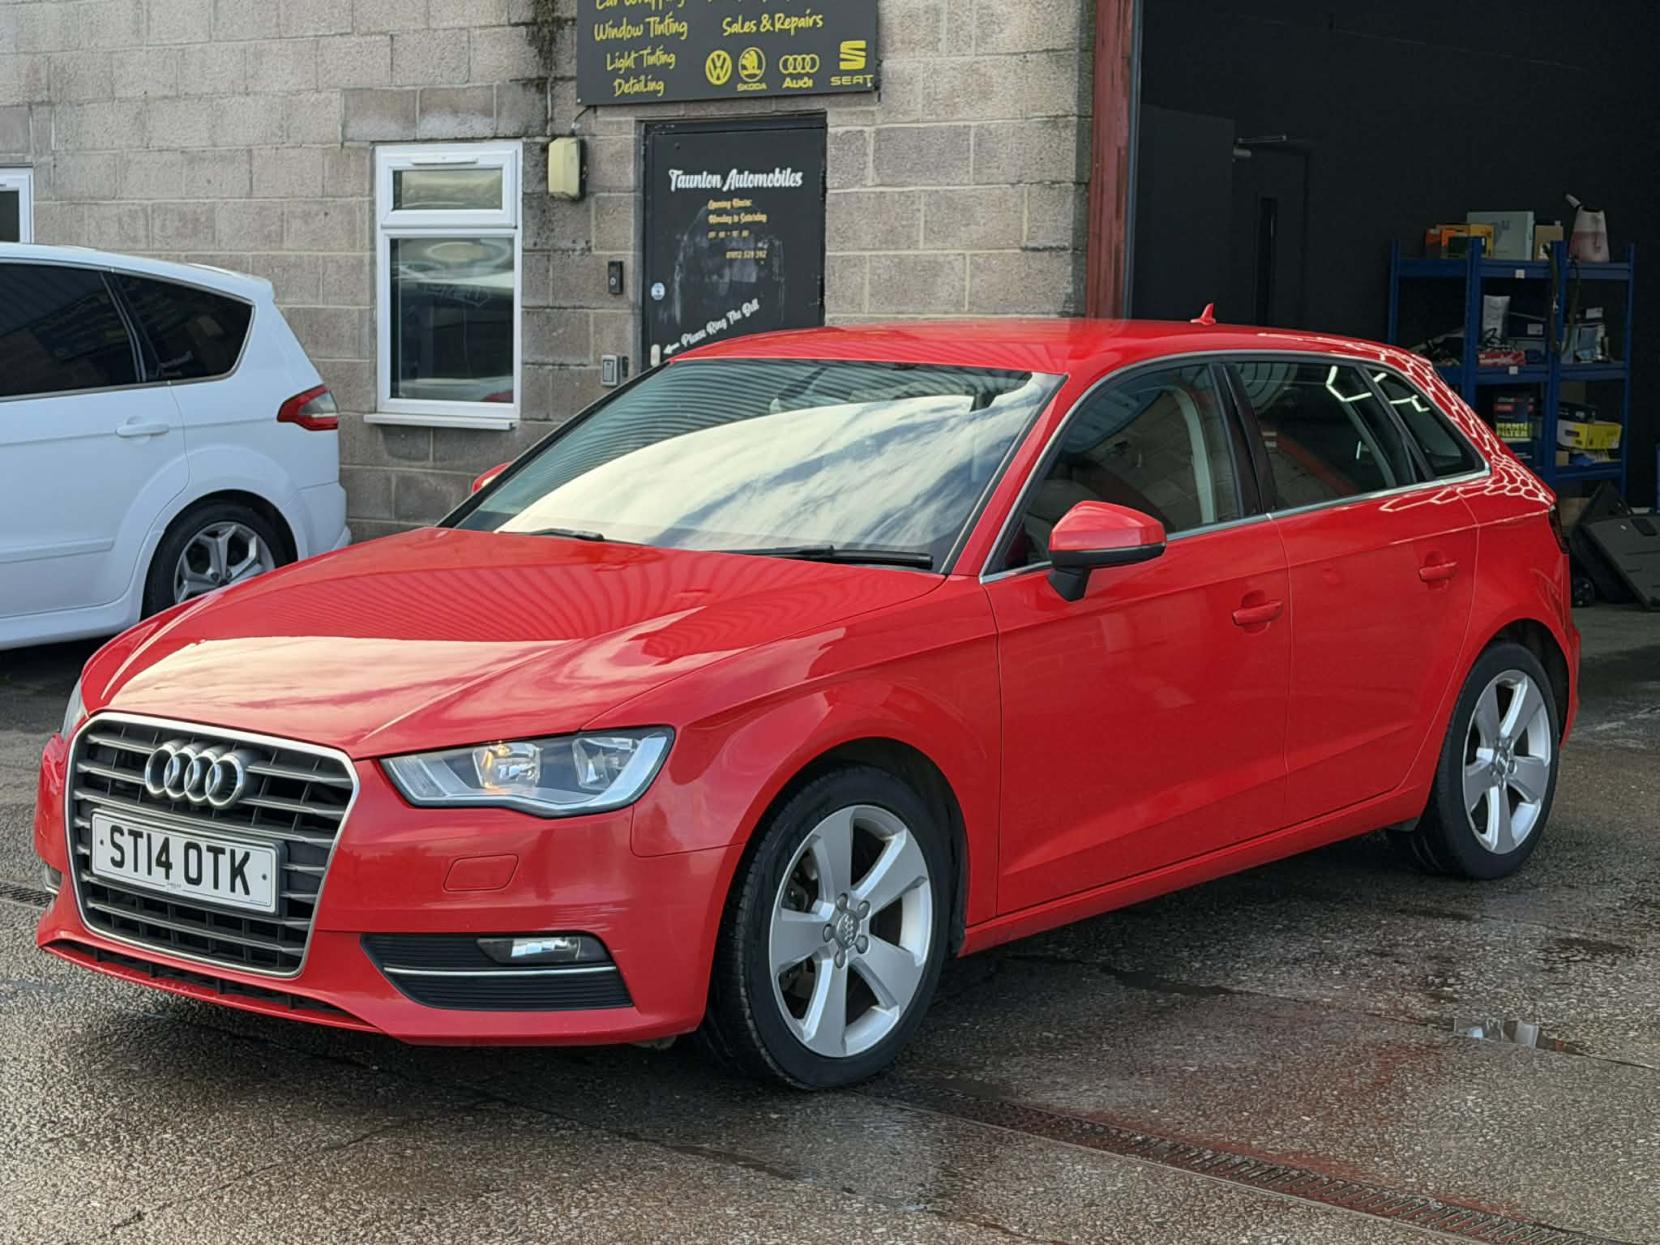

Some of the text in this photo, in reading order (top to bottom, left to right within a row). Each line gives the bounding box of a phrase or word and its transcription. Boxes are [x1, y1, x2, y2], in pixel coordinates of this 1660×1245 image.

[594, 11, 688, 41] Window Tinting
[722, 9, 823, 36] Sales & Repairs
[606, 45, 676, 74] Light Tinting
[613, 75, 665, 97] Detailing
[782, 77, 813, 89] Audi
[830, 74, 874, 87] SEAT
[668, 167, 803, 192] Taunton Automobiles
[110, 824, 251, 896] ST14 OTK
